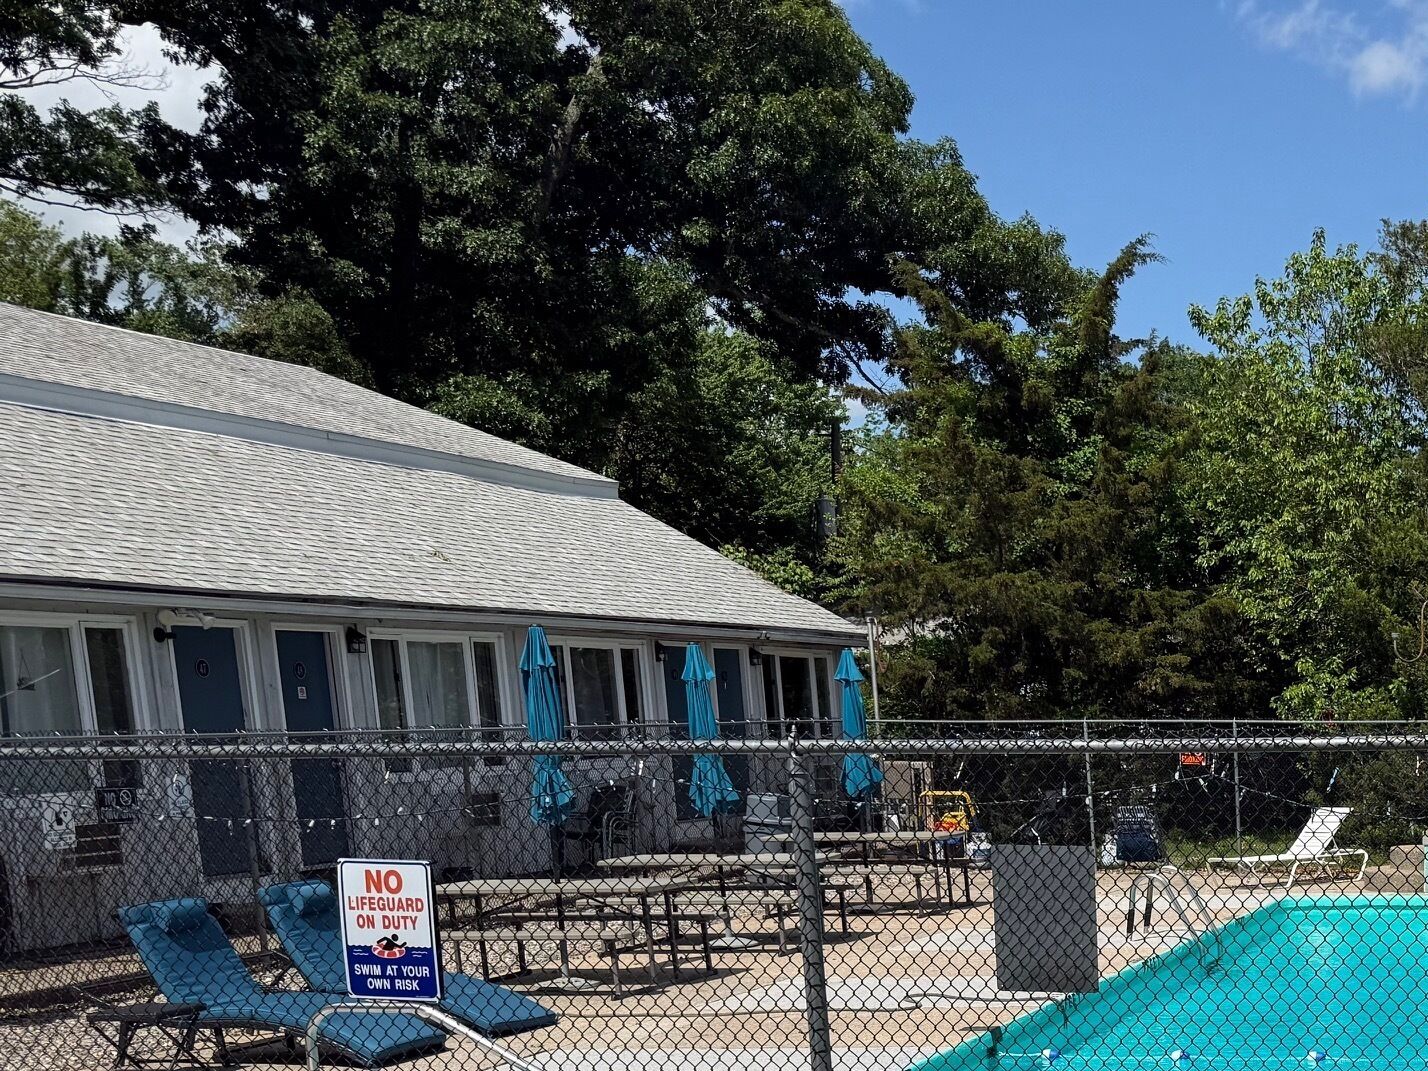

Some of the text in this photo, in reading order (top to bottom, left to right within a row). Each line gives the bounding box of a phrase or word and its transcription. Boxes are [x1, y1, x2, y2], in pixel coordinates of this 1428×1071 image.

[364, 869, 403, 894] NO
[348, 896, 424, 912] LIFEGUARD
[356, 914, 418, 930] ON DUTY
[354, 963, 430, 977] SWIM AT YOUR
[367, 977, 420, 991] OWN RISK
